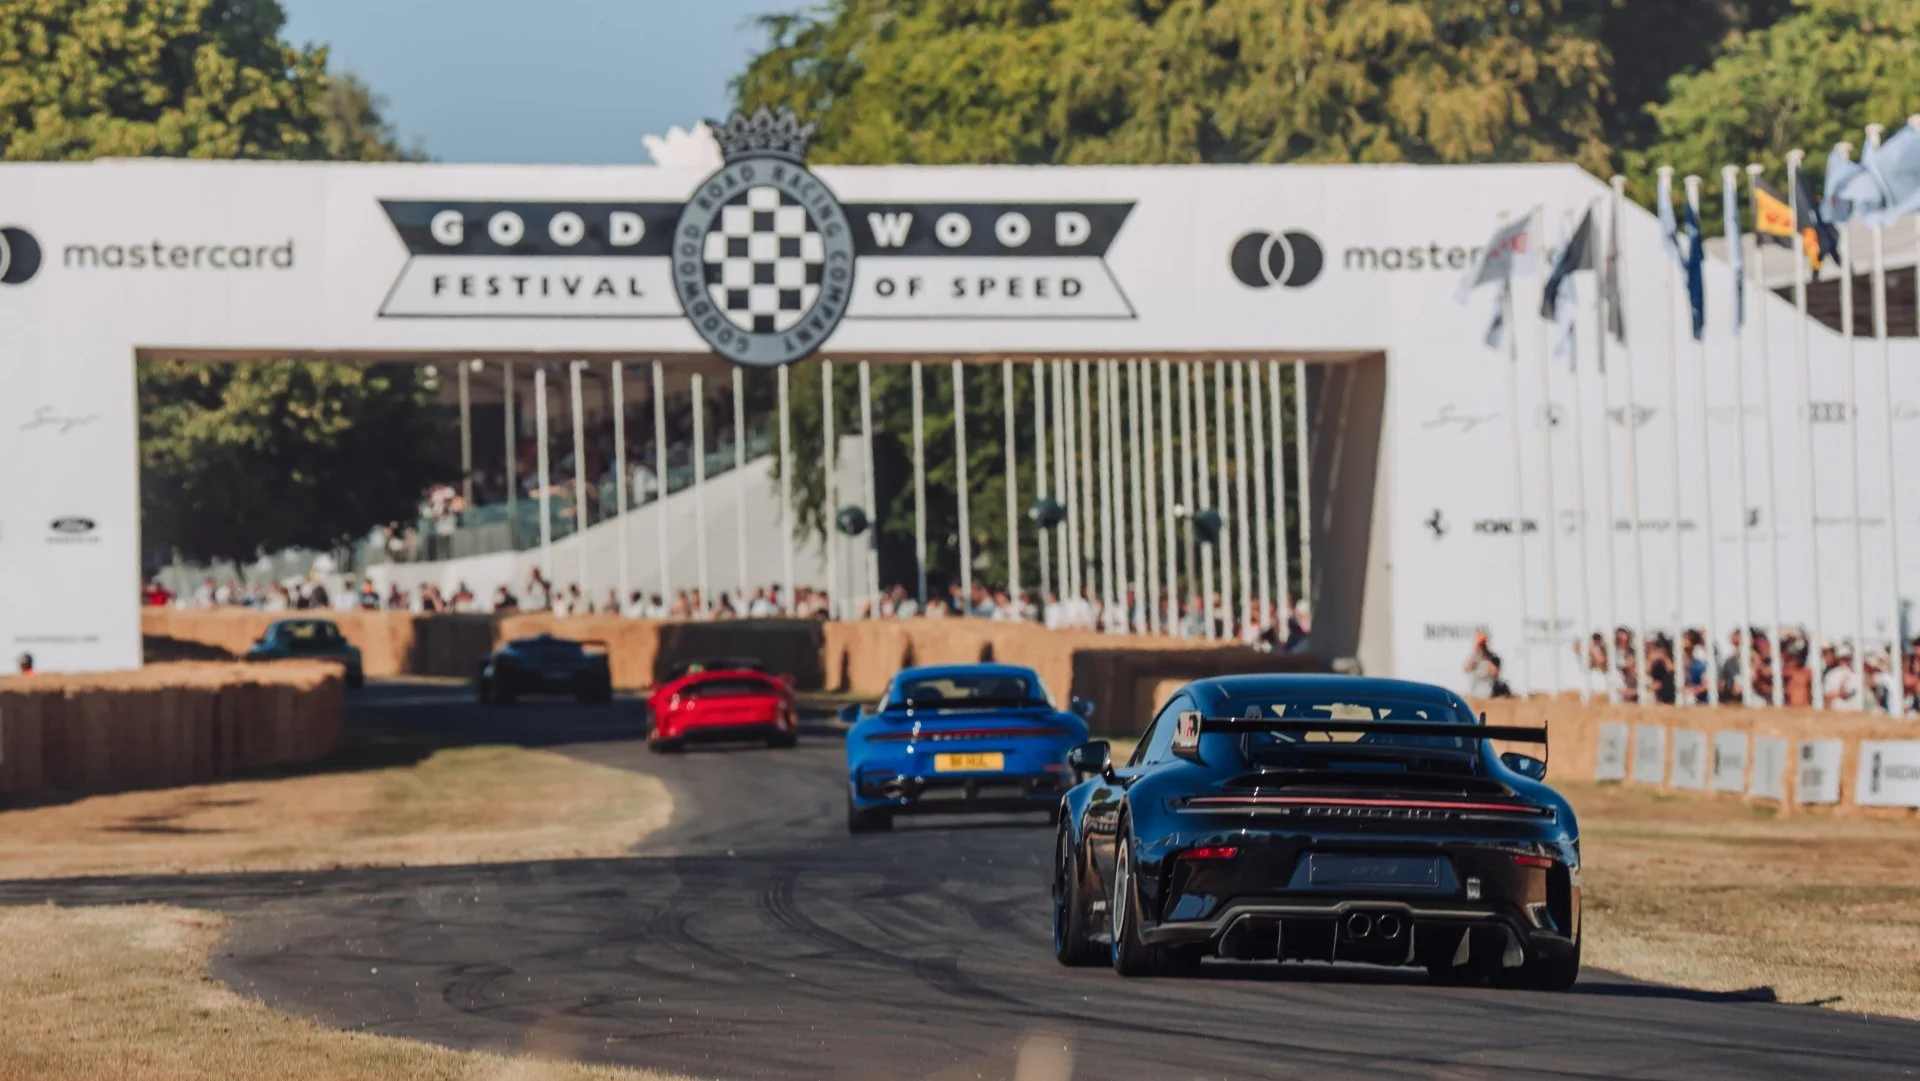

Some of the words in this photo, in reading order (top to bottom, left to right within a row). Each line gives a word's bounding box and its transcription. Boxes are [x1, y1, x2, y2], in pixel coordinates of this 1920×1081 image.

[430, 209, 646, 246] GOOD
[866, 211, 1092, 247] WOOD
[62, 238, 295, 270] mastercard
[432, 275, 647, 298] FESTIVAL
[875, 278, 923, 298] OF
[952, 277, 1083, 298] SPEED
